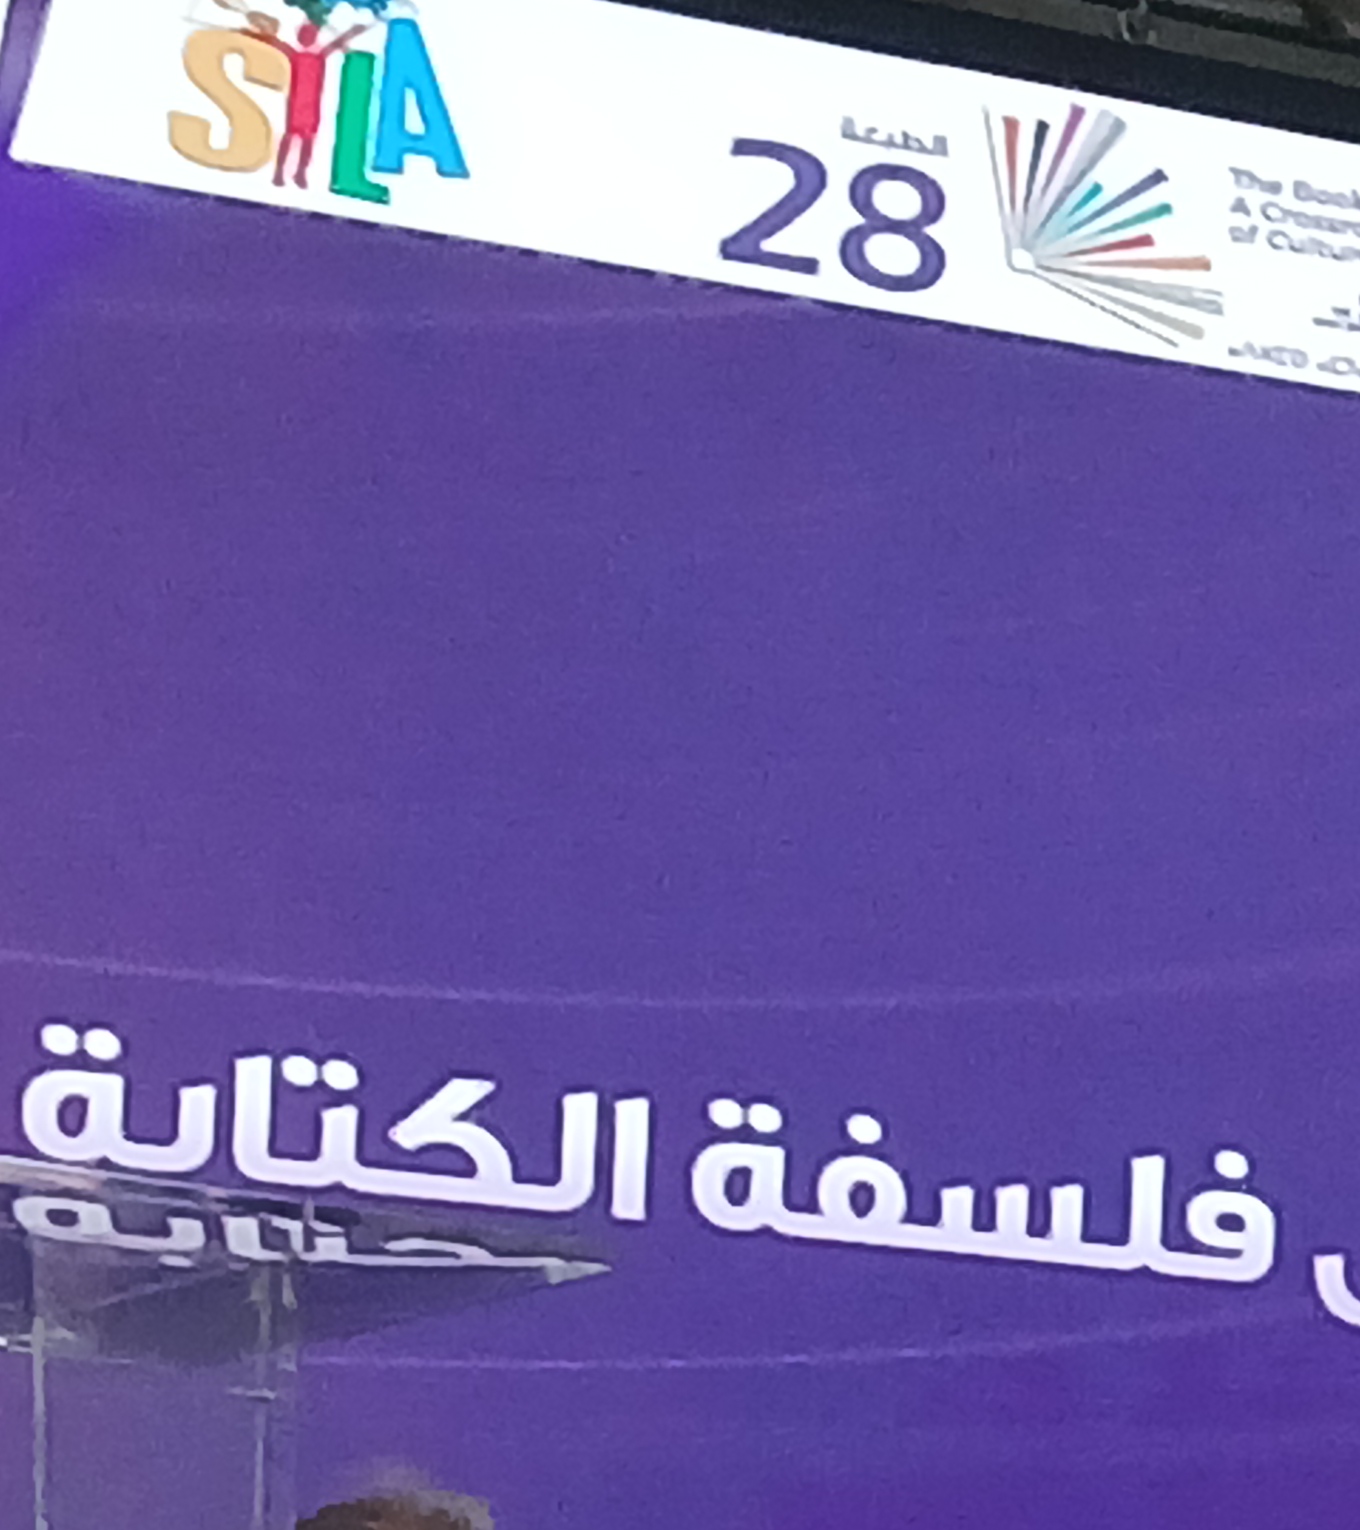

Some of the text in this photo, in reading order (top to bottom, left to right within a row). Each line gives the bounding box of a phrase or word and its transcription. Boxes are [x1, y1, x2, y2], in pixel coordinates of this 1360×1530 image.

[718, 136, 946, 293] 28
[21, 1023, 650, 1221] الكتابة
[690, 1097, 1278, 1284] فلسفة
